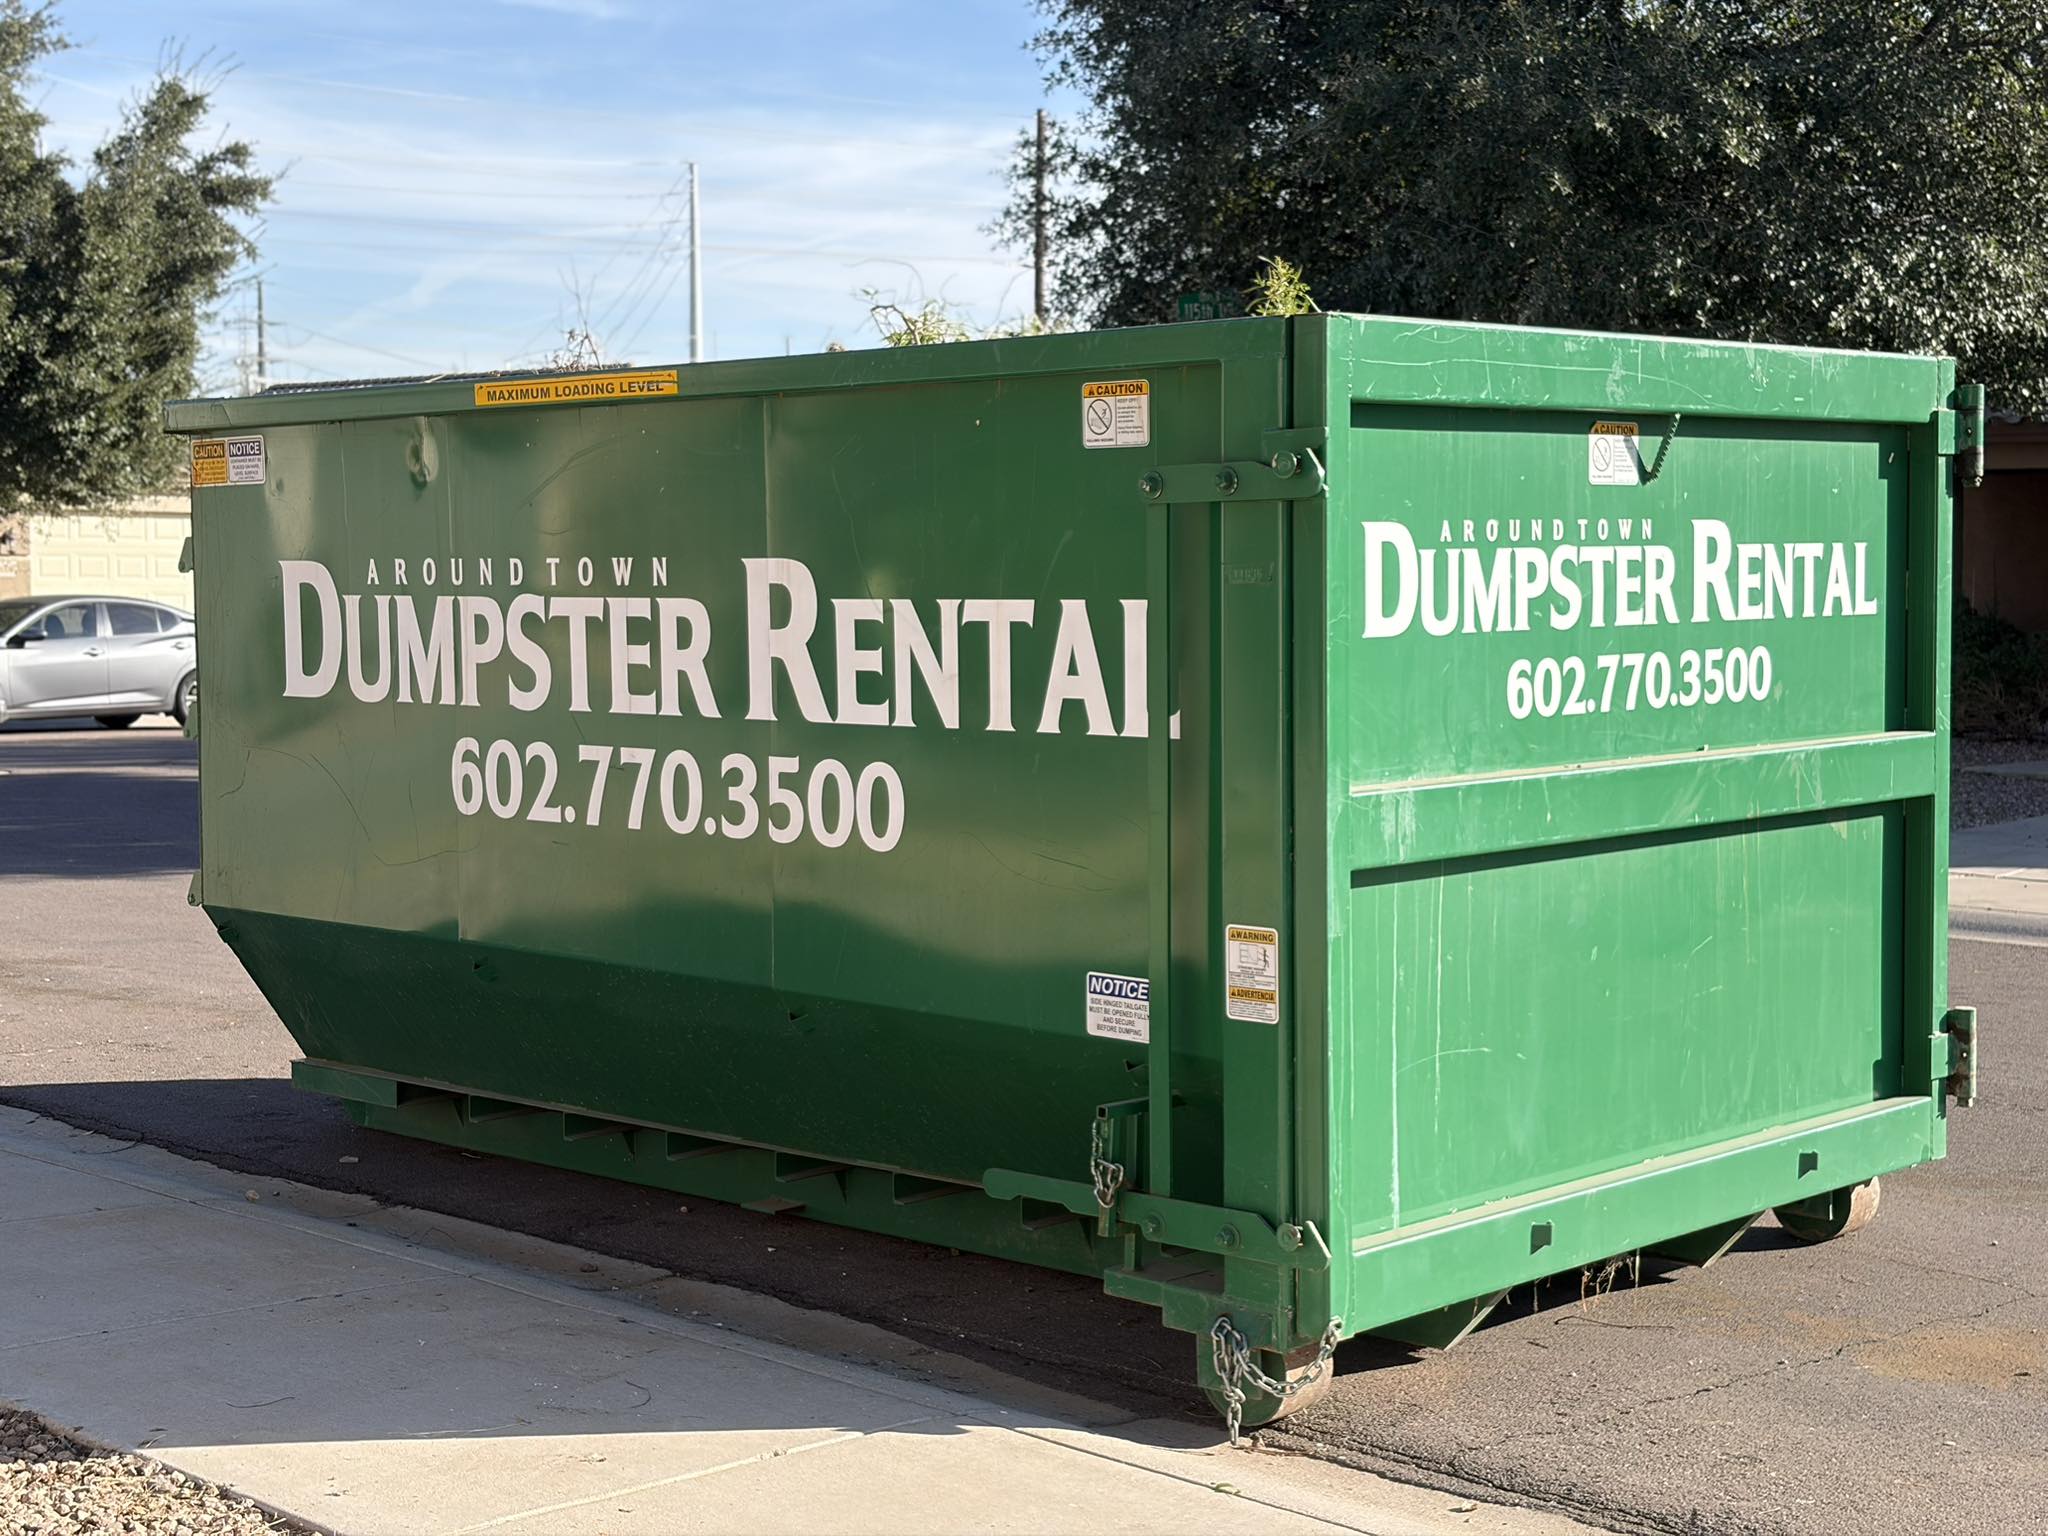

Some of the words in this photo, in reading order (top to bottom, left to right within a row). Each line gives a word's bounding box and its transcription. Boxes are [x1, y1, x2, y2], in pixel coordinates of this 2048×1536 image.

[486, 386, 551, 402] MAXIMUM
[555, 381, 615, 398] LOADING
[619, 379, 664, 394] LEVEL
[1096, 383, 1143, 396] CAUTION
[1600, 423, 1635, 435] CAUTION
[194, 444, 224, 458] CAUTION
[229, 442, 260, 456] NOTICE
[1439, 518, 1565, 543] AROUND
[1577, 517, 1653, 541] TOWN
[367, 557, 526, 587] AROUND
[545, 556, 669, 588] TOWN
[1360, 520, 1681, 639] DUMPSTER
[1690, 518, 1878, 623] RENTAL
[278, 560, 722, 720] DUMPSTER
[740, 557, 1181, 740] RENTAL
[1506, 645, 1773, 721] 602.770.3500
[451, 736, 905, 853] 602.770.3500
[1236, 931, 1274, 943] WARNING
[1090, 976, 1149, 1000] NOTICE
[1237, 990, 1275, 1001] ADVERTENCIA
[1089, 1006, 1103, 1014] MUST
[1112, 1009, 1133, 1018] OPENED
[1090, 998, 1102, 1006] SIDE
[1103, 999, 1122, 1008] HINGED
[1123, 1001, 1148, 1012] TAILGATE
[1103, 1016, 1114, 1024] AND
[1115, 1017, 1135, 1027] SECURE
[1097, 1023, 1117, 1032] BEFORE
[1118, 1026, 1142, 1037] DUMPING
